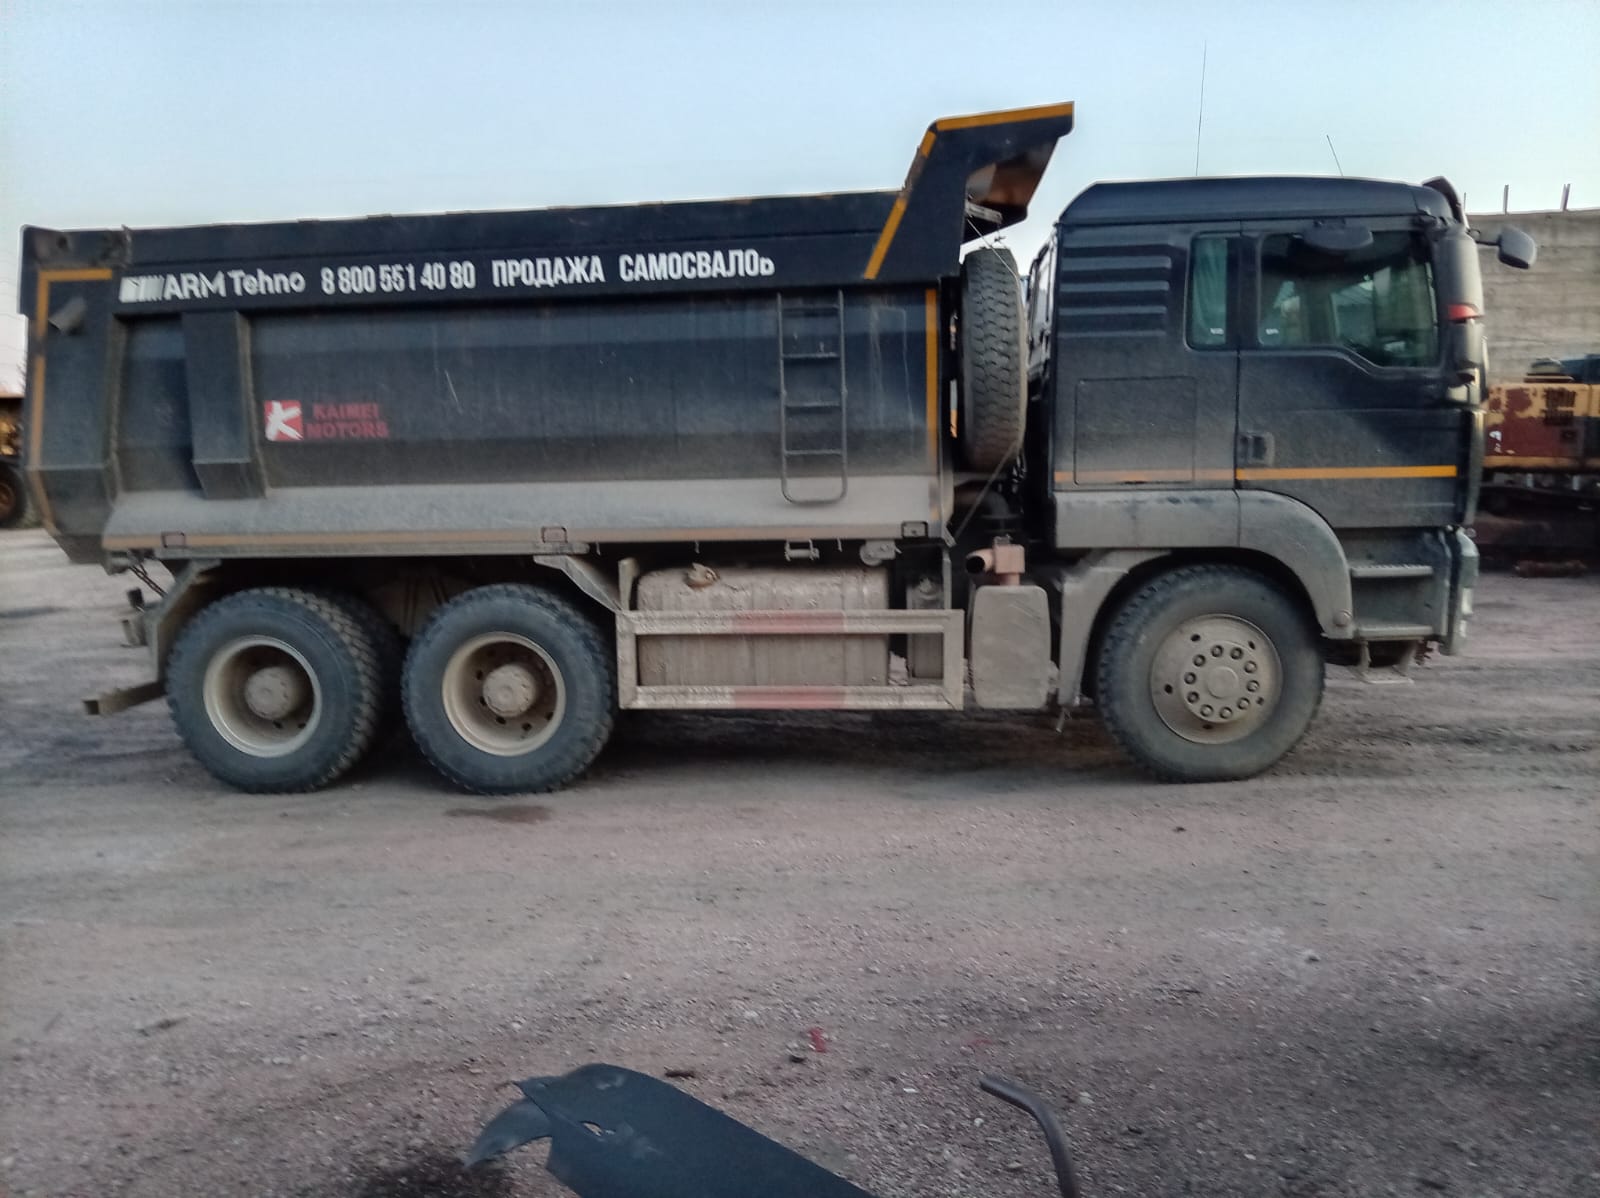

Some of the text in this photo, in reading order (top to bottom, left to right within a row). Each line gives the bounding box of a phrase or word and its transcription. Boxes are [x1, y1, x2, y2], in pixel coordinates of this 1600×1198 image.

[163, 269, 305, 300] ARM Tehno
[320, 260, 476, 295] 8 800 551 40 80
[491, 255, 605, 288] ПРОДАЖА
[306, 420, 389, 438] MOTORS
